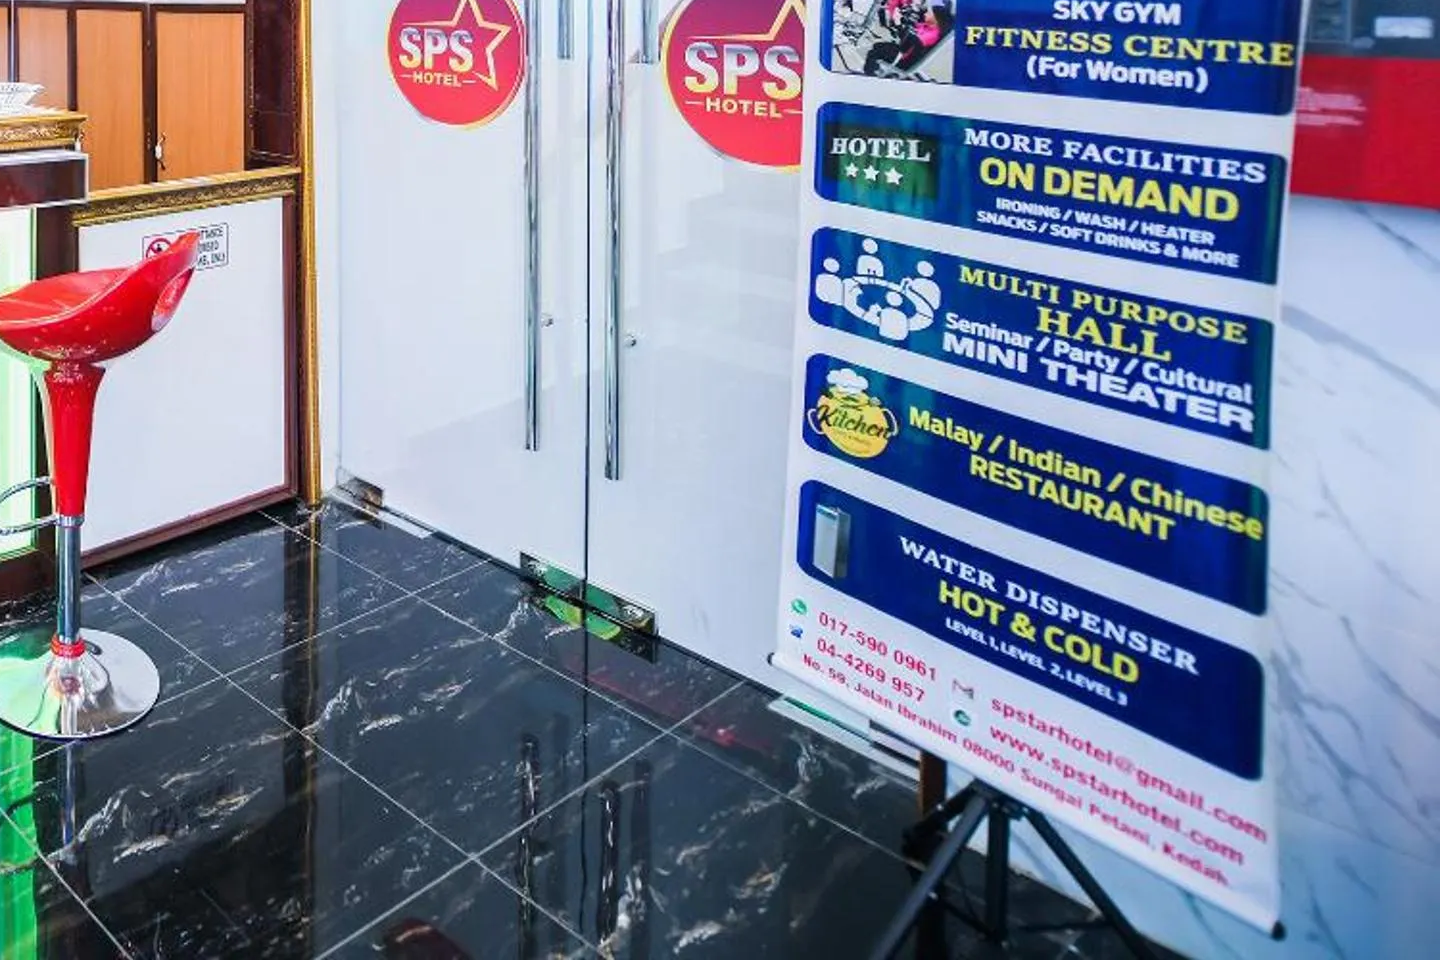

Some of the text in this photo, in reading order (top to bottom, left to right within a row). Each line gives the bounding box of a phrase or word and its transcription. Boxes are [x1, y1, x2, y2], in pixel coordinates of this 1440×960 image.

[1113, 0, 1182, 26] GYM
[398, 27, 475, 73] SPS
[684, 41, 802, 101] SPS
[964, 25, 1296, 67] FITNESS CENTRE
[1026, 54, 1209, 93] (For Women)
[412, 70, 463, 88] HOTEL
[704, 96, 783, 119] HOTEL
[829, 137, 931, 162] HOTEL
[962, 127, 1267, 185] MORE FACILITIES
[979, 156, 1240, 222] ON DEMAND
[995, 197, 1061, 220] IRONING
[1073, 210, 1126, 232] WASH
[1140, 221, 1216, 246] HEATER
[976, 210, 1038, 233] SNACKS
[1049, 223, 1095, 243] SOFT
[1094, 232, 1161, 255] DRINKS
[1162, 243, 1179, 259] &
[1181, 247, 1240, 268] MORE
[958, 263, 1249, 345] MULTI PURPOSE
[1036, 305, 1173, 363] HALL
[941, 332, 1256, 434] MINI THEATER
[945, 311, 1034, 350] Seminar
[1053, 339, 1120, 375] Party
[1141, 361, 1254, 405] Cultural
[817, 404, 888, 438] Kitchen
[909, 406, 984, 453] Malay
[1008, 439, 1102, 489] Indian
[1130, 478, 1264, 540] Chinese
[969, 455, 1177, 541] RESTAURANT
[899, 536, 1200, 676] WATER DISPENSER
[938, 580, 1140, 683] HOT & COLD
[816, 638, 926, 703] 04-4269 957
[818, 612, 937, 681] 017-590 0961
[945, 617, 987, 646] LEVEL
[1002, 641, 1046, 671] LEVEL
[1067, 669, 1116, 701] LEVEL
[1117, 693, 1128, 706] 3
[854, 681, 894, 710] Jalan
[897, 703, 958, 744] Ibrahim
[962, 738, 1016, 773] 08000
[1020, 767, 1083, 810] Sungai
[991, 697, 1268, 844] spstarhotel@gmail.com
[989, 725, 1245, 866] www.spstarhotel.com
